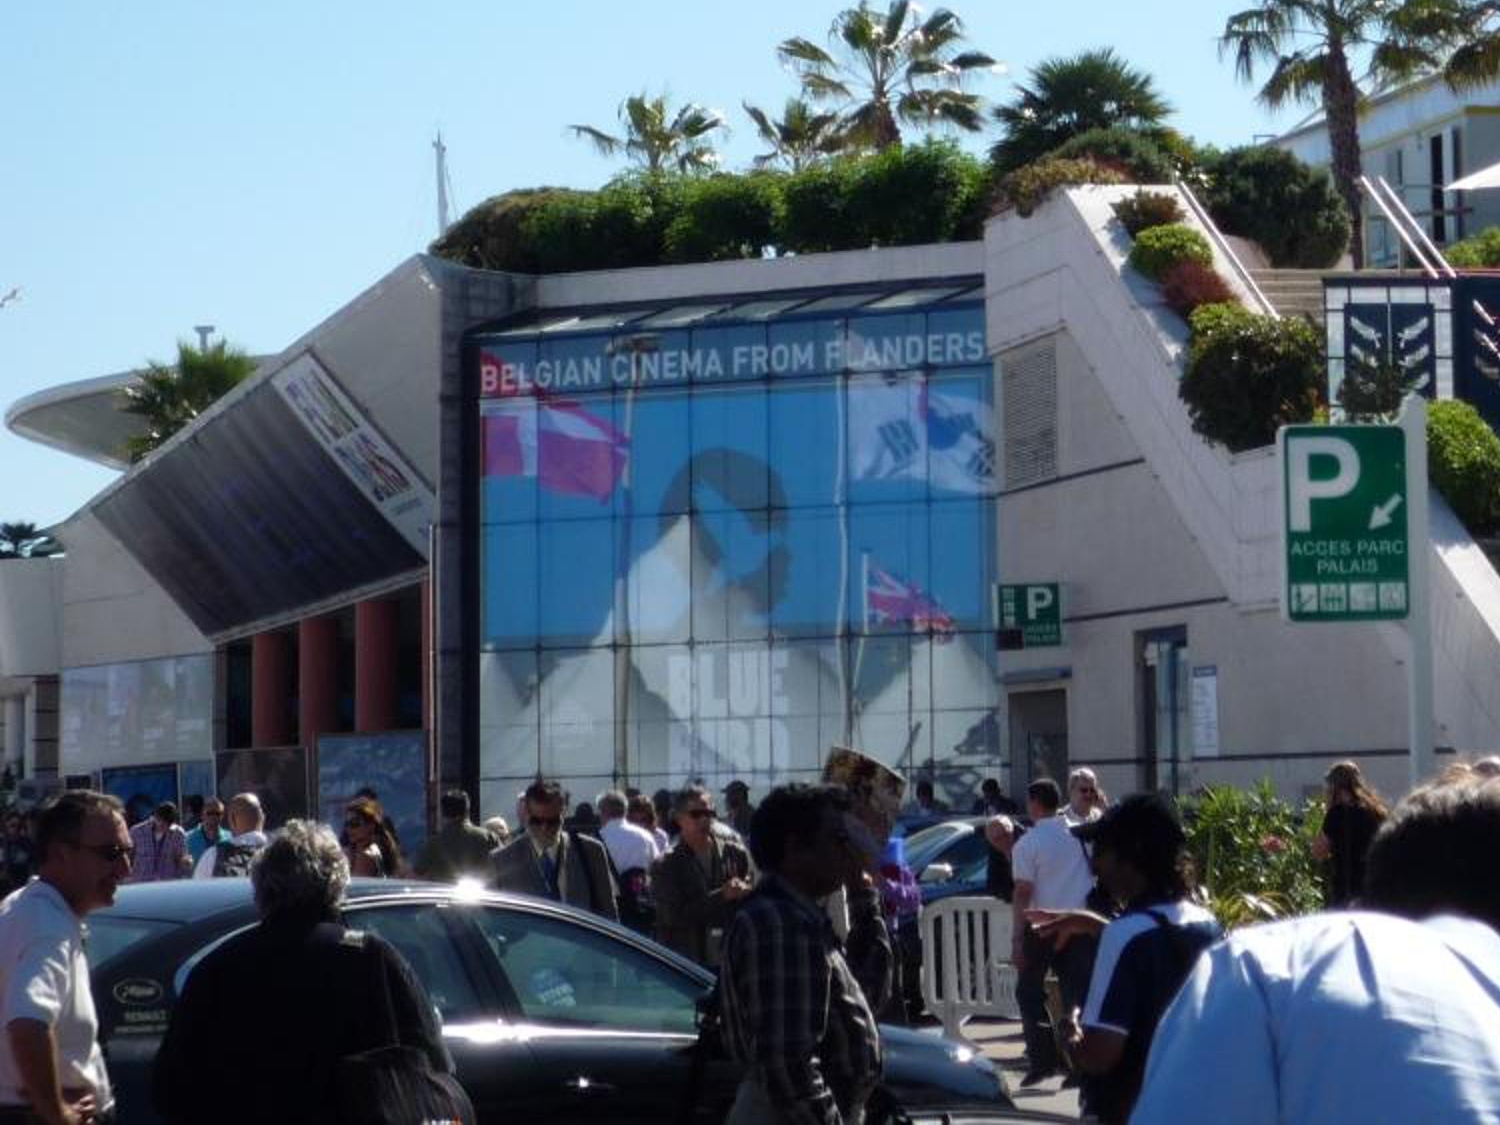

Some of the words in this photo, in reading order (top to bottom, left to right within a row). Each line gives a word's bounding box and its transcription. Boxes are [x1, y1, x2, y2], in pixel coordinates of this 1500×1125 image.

[481, 356, 600, 392] BELGIAN
[610, 350, 724, 382] CINEMA
[733, 342, 814, 375] FROM
[825, 332, 984, 370] FLANDERS
[1288, 436, 1361, 532] P
[1291, 541, 1351, 556] ACCES
[1357, 540, 1406, 555] PARC
[1316, 558, 1378, 574] PALAIS
[1027, 586, 1053, 620] P
[669, 650, 789, 716] BLUE
